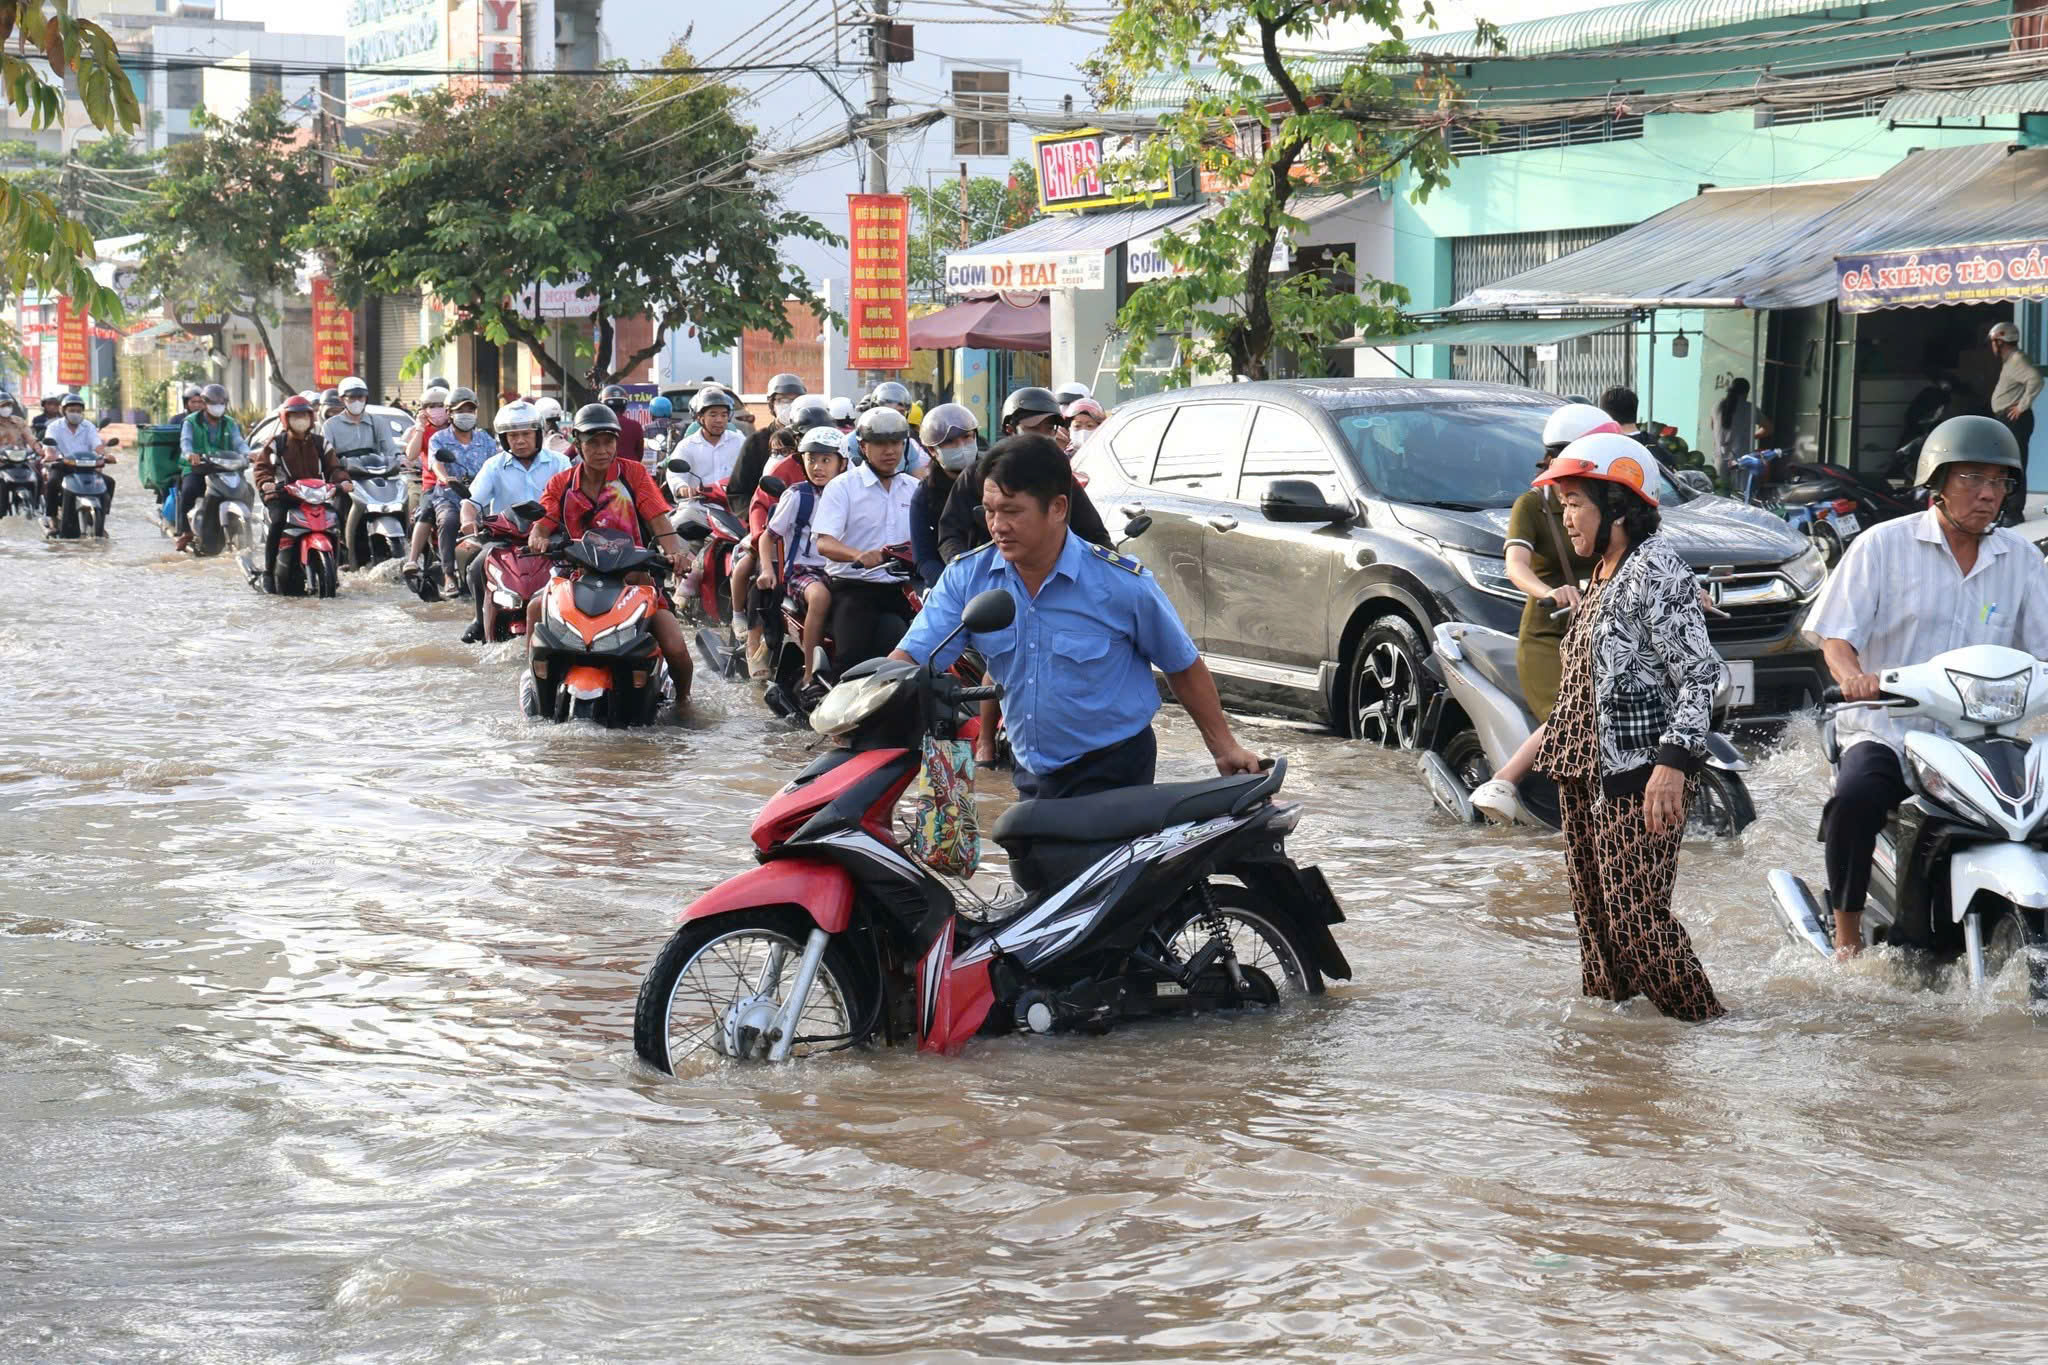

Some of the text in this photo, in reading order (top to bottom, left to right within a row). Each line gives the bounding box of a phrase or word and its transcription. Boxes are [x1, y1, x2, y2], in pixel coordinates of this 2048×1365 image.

[948, 264, 986, 287] CƠM
[991, 259, 1013, 287] DÌ
[1020, 263, 1057, 287] HAI
[1843, 265, 1874, 292] CÁ
[1956, 256, 2004, 284] TÈO
